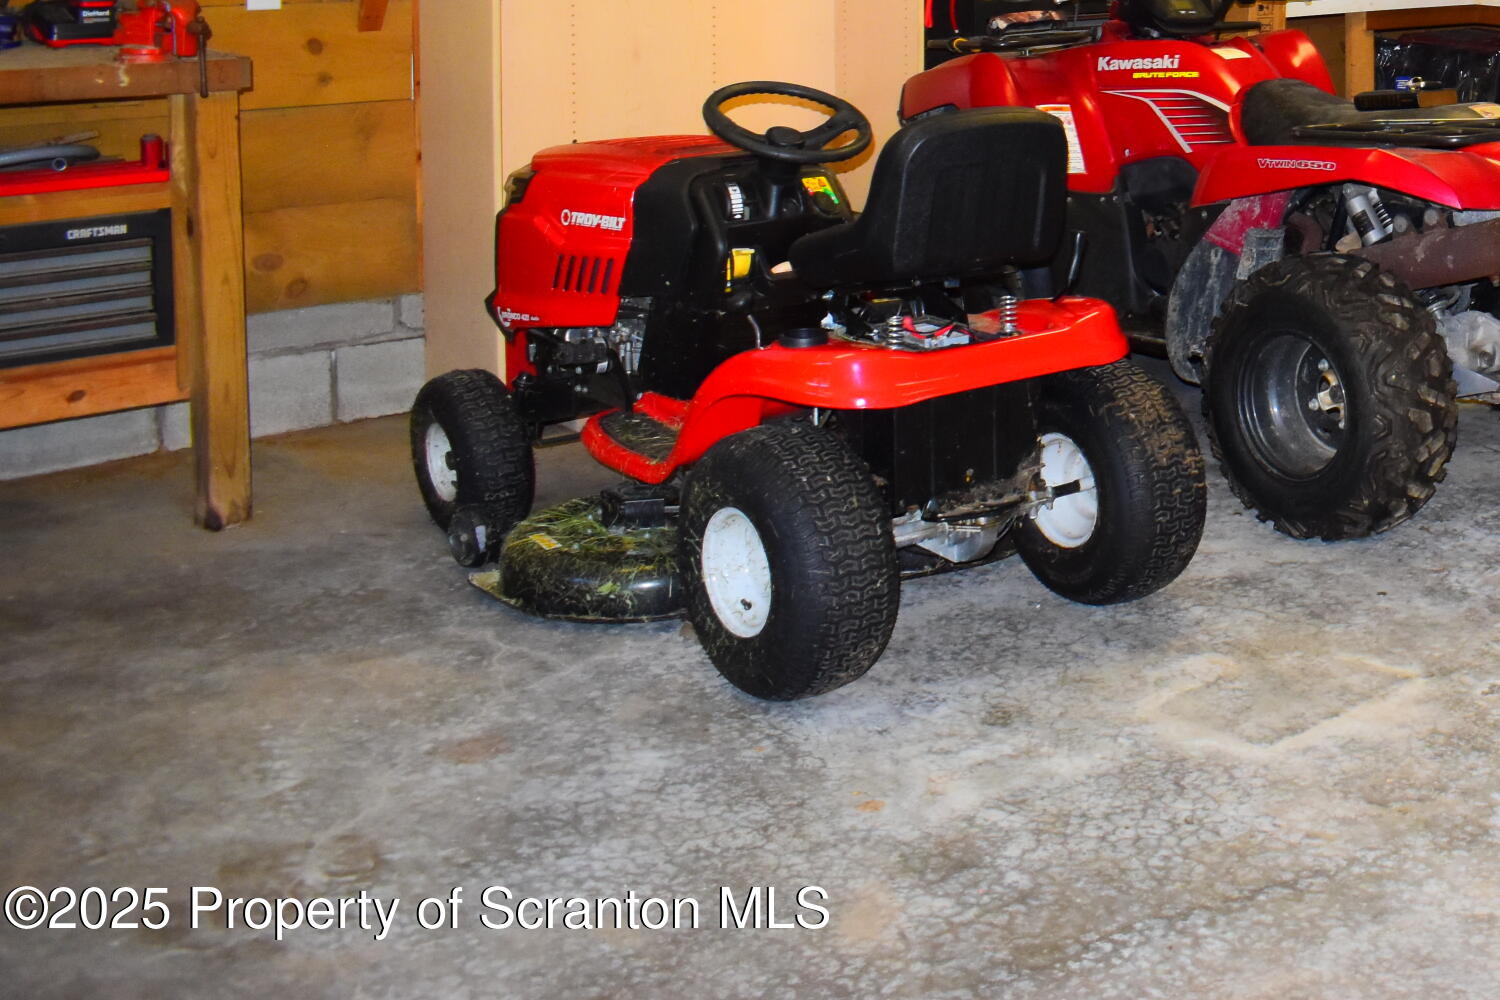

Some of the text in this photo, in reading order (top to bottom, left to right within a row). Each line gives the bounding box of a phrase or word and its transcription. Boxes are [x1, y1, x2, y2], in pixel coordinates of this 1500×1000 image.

[1097, 55, 1180, 71] Kawasaki
[571, 211, 626, 231] TROY-BILT
[66, 224, 128, 240] CRAFTSMAN
